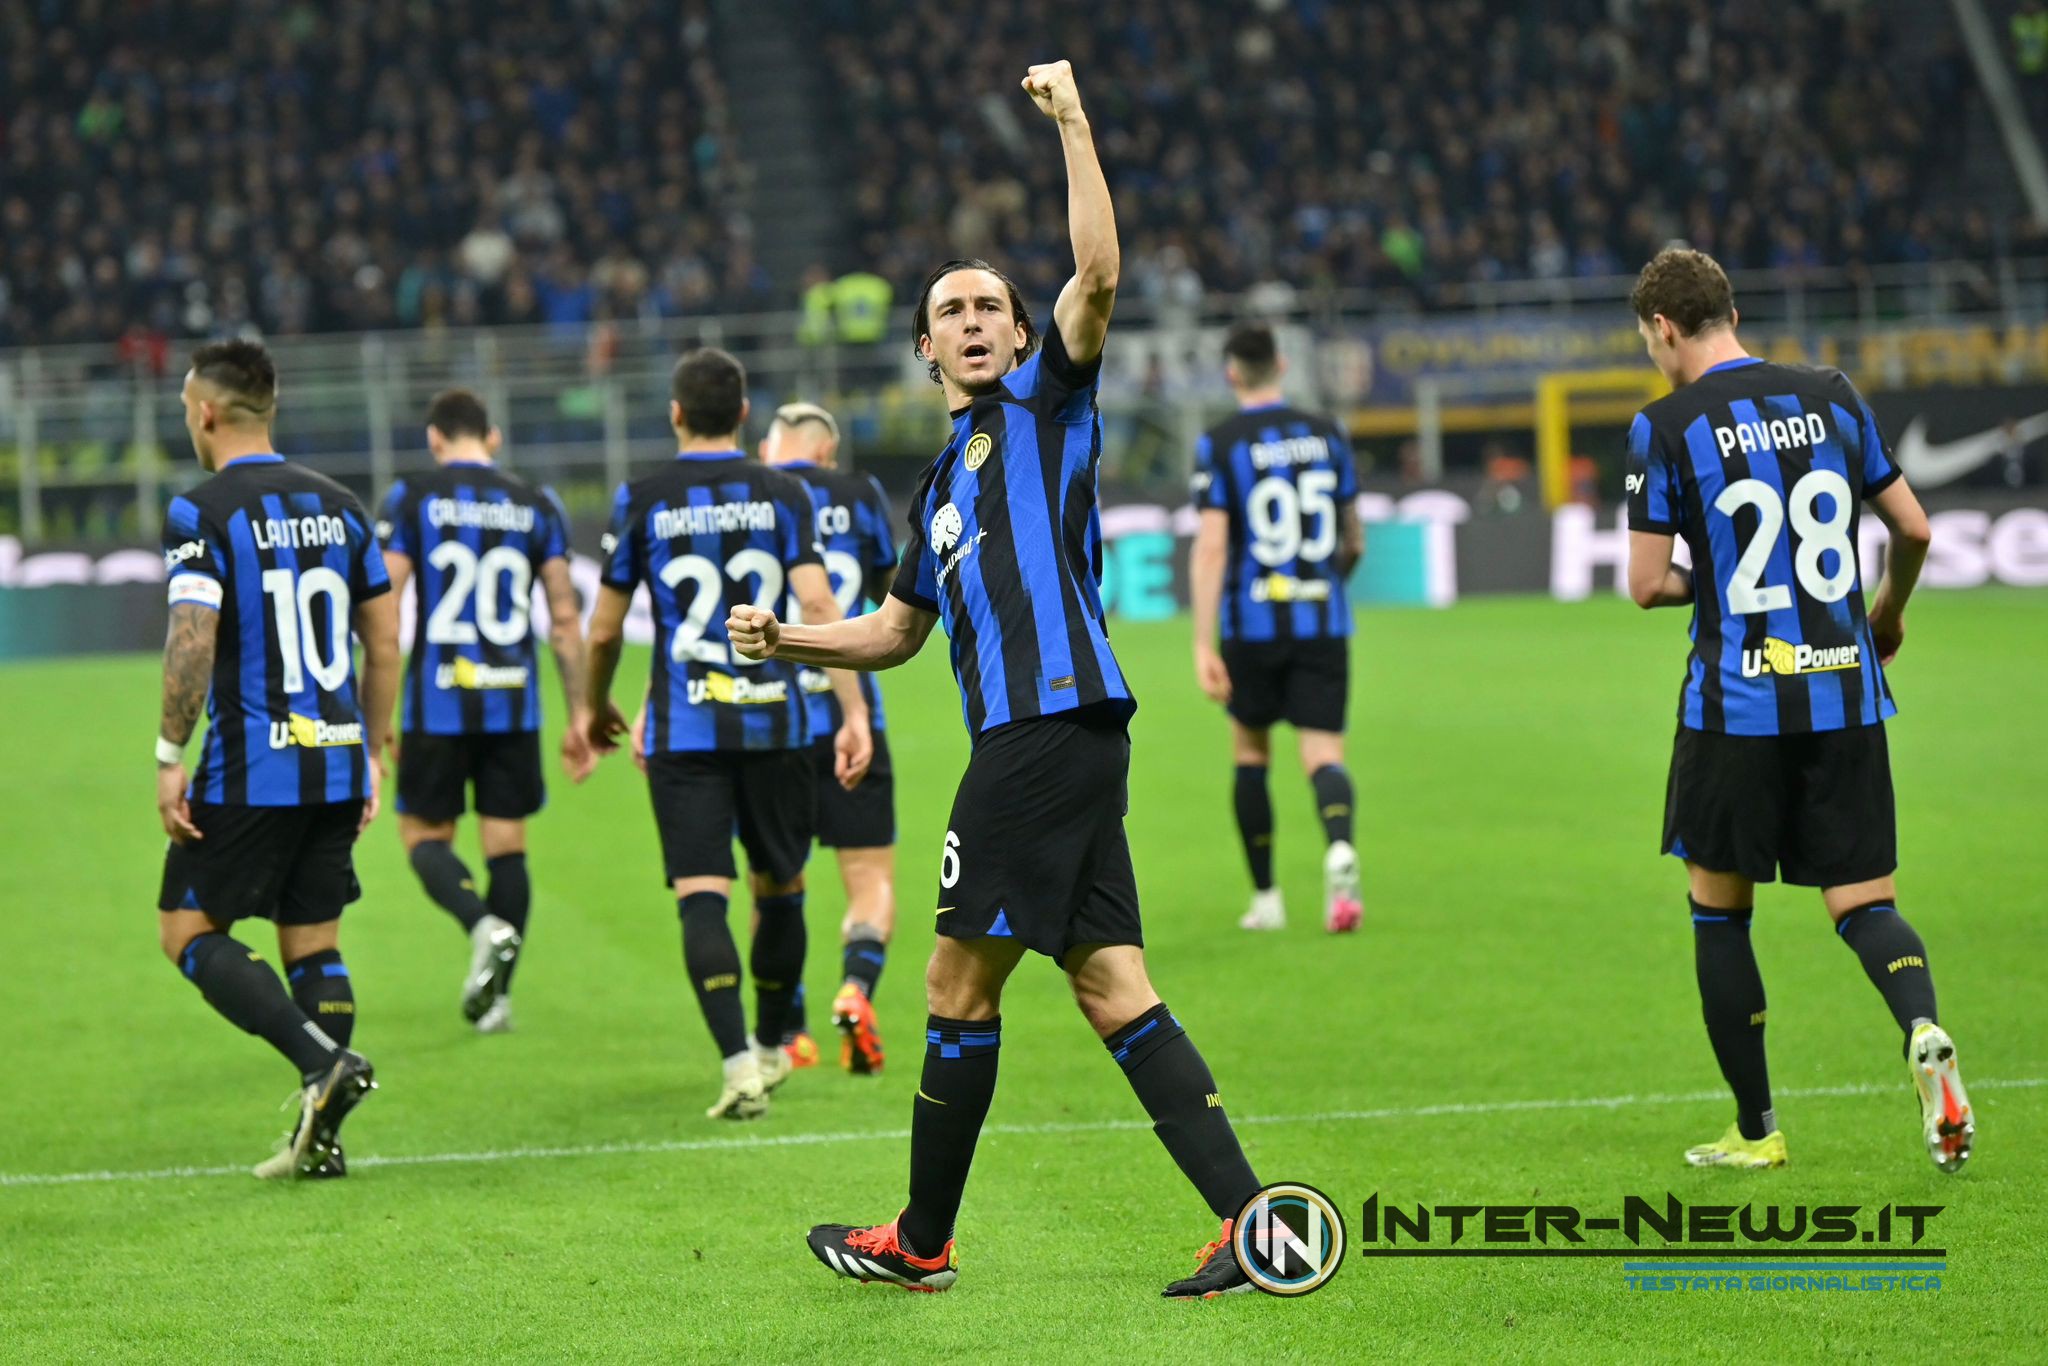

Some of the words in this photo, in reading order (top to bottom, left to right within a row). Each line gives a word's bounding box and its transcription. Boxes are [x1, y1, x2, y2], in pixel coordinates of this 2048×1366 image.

[1715, 413, 1826, 458] PAVARD
[1625, 473, 1645, 495] ay
[252, 515, 346, 549] LAUTARO
[1246, 474, 1338, 567] 95
[1714, 469, 1856, 615] 28
[427, 540, 531, 646] 20
[262, 567, 350, 693] 10
[1887, 955, 1923, 973] INTER
